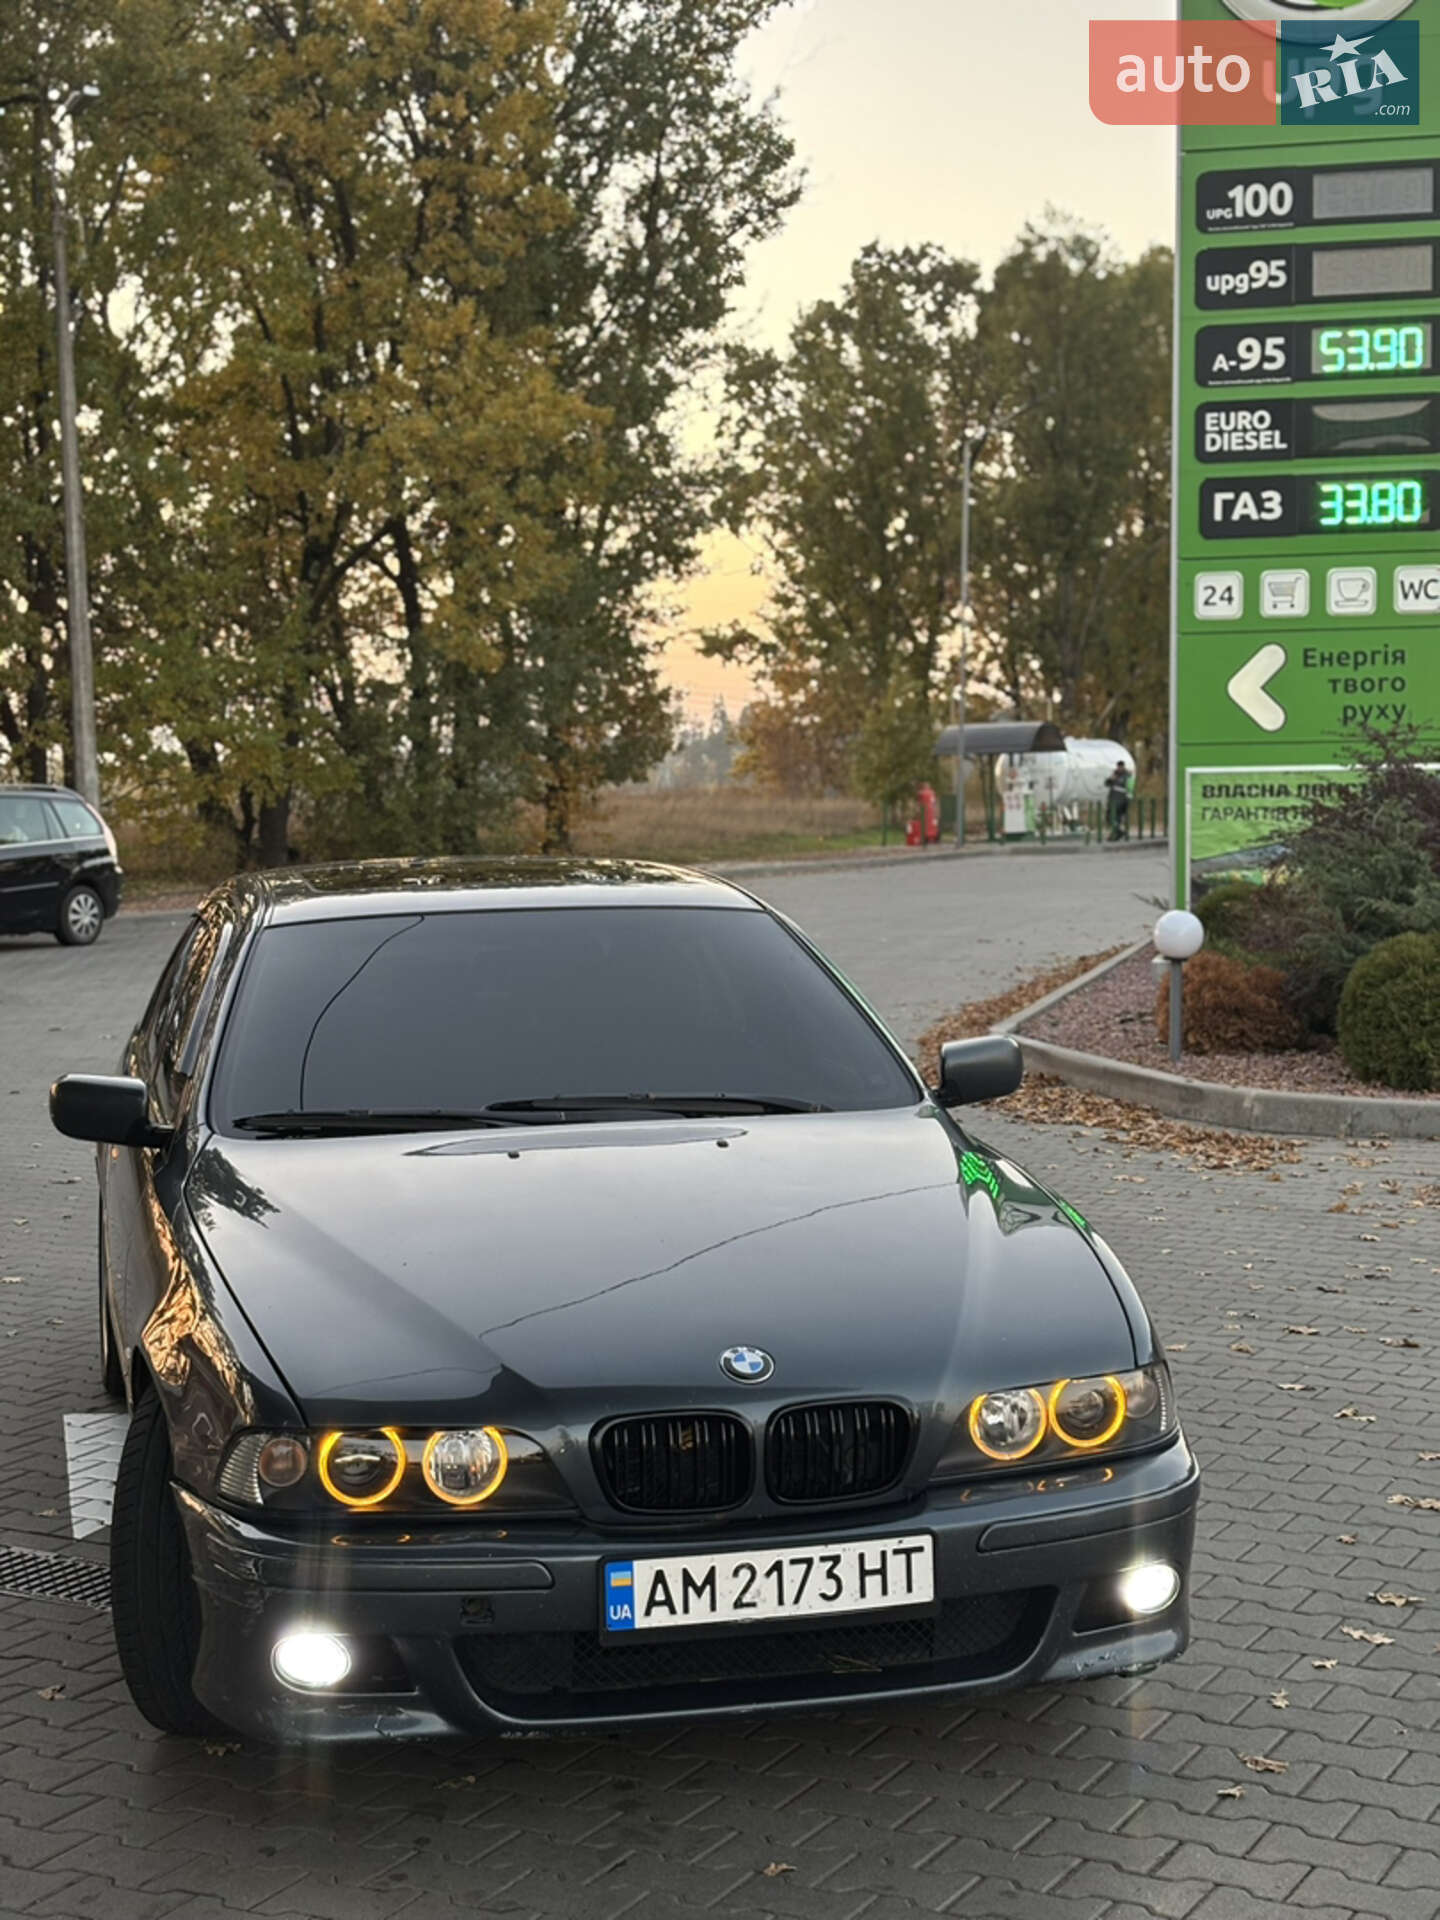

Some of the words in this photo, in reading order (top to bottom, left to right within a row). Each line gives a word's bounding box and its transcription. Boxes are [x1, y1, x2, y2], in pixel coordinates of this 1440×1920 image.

[1319, 326, 1424, 374] 53.90
[1204, 410, 1272, 431] EURO
[1204, 430, 1288, 453] DIESEL
[1213, 489, 1283, 522] ГАЗ
[1319, 480, 1423, 527] 33.80
[1202, 585, 1235, 607] 24
[1400, 578, 1440, 601] WC
[1302, 643, 1407, 671] Енергія
[1328, 675, 1407, 695] твого
[1342, 702, 1407, 727] руху
[1201, 783, 1290, 799] ВЛАСНА
[644, 1565, 718, 1617] AM
[732, 1554, 844, 1610] 2173
[858, 1545, 926, 1599] HT
[610, 1603, 633, 1621] UA
